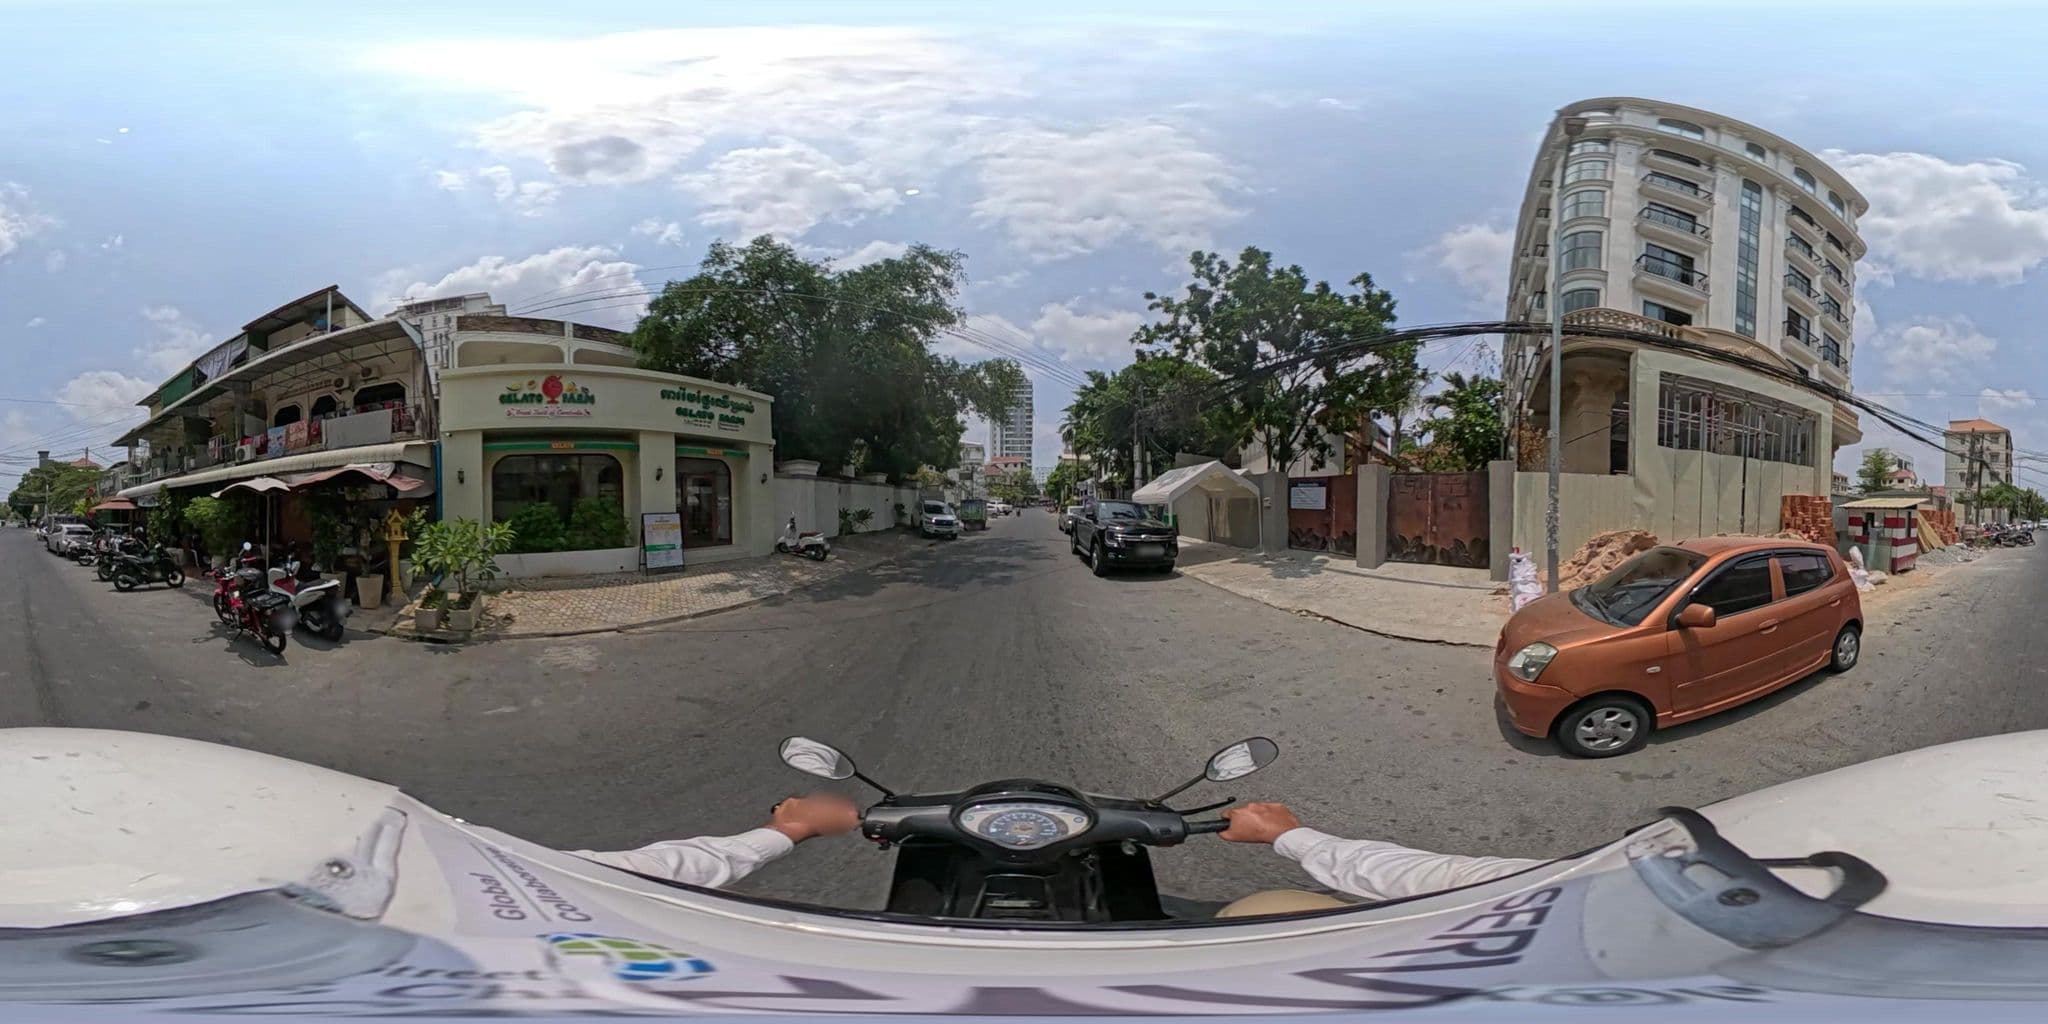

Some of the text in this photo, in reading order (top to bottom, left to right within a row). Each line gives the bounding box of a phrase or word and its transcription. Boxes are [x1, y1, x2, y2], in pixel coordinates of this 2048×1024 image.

[499, 393, 595, 405] GELATO FARM
[675, 407, 715, 420] GELATO
[468, 872, 527, 921] Global
[485, 846, 592, 922] Collaborative
